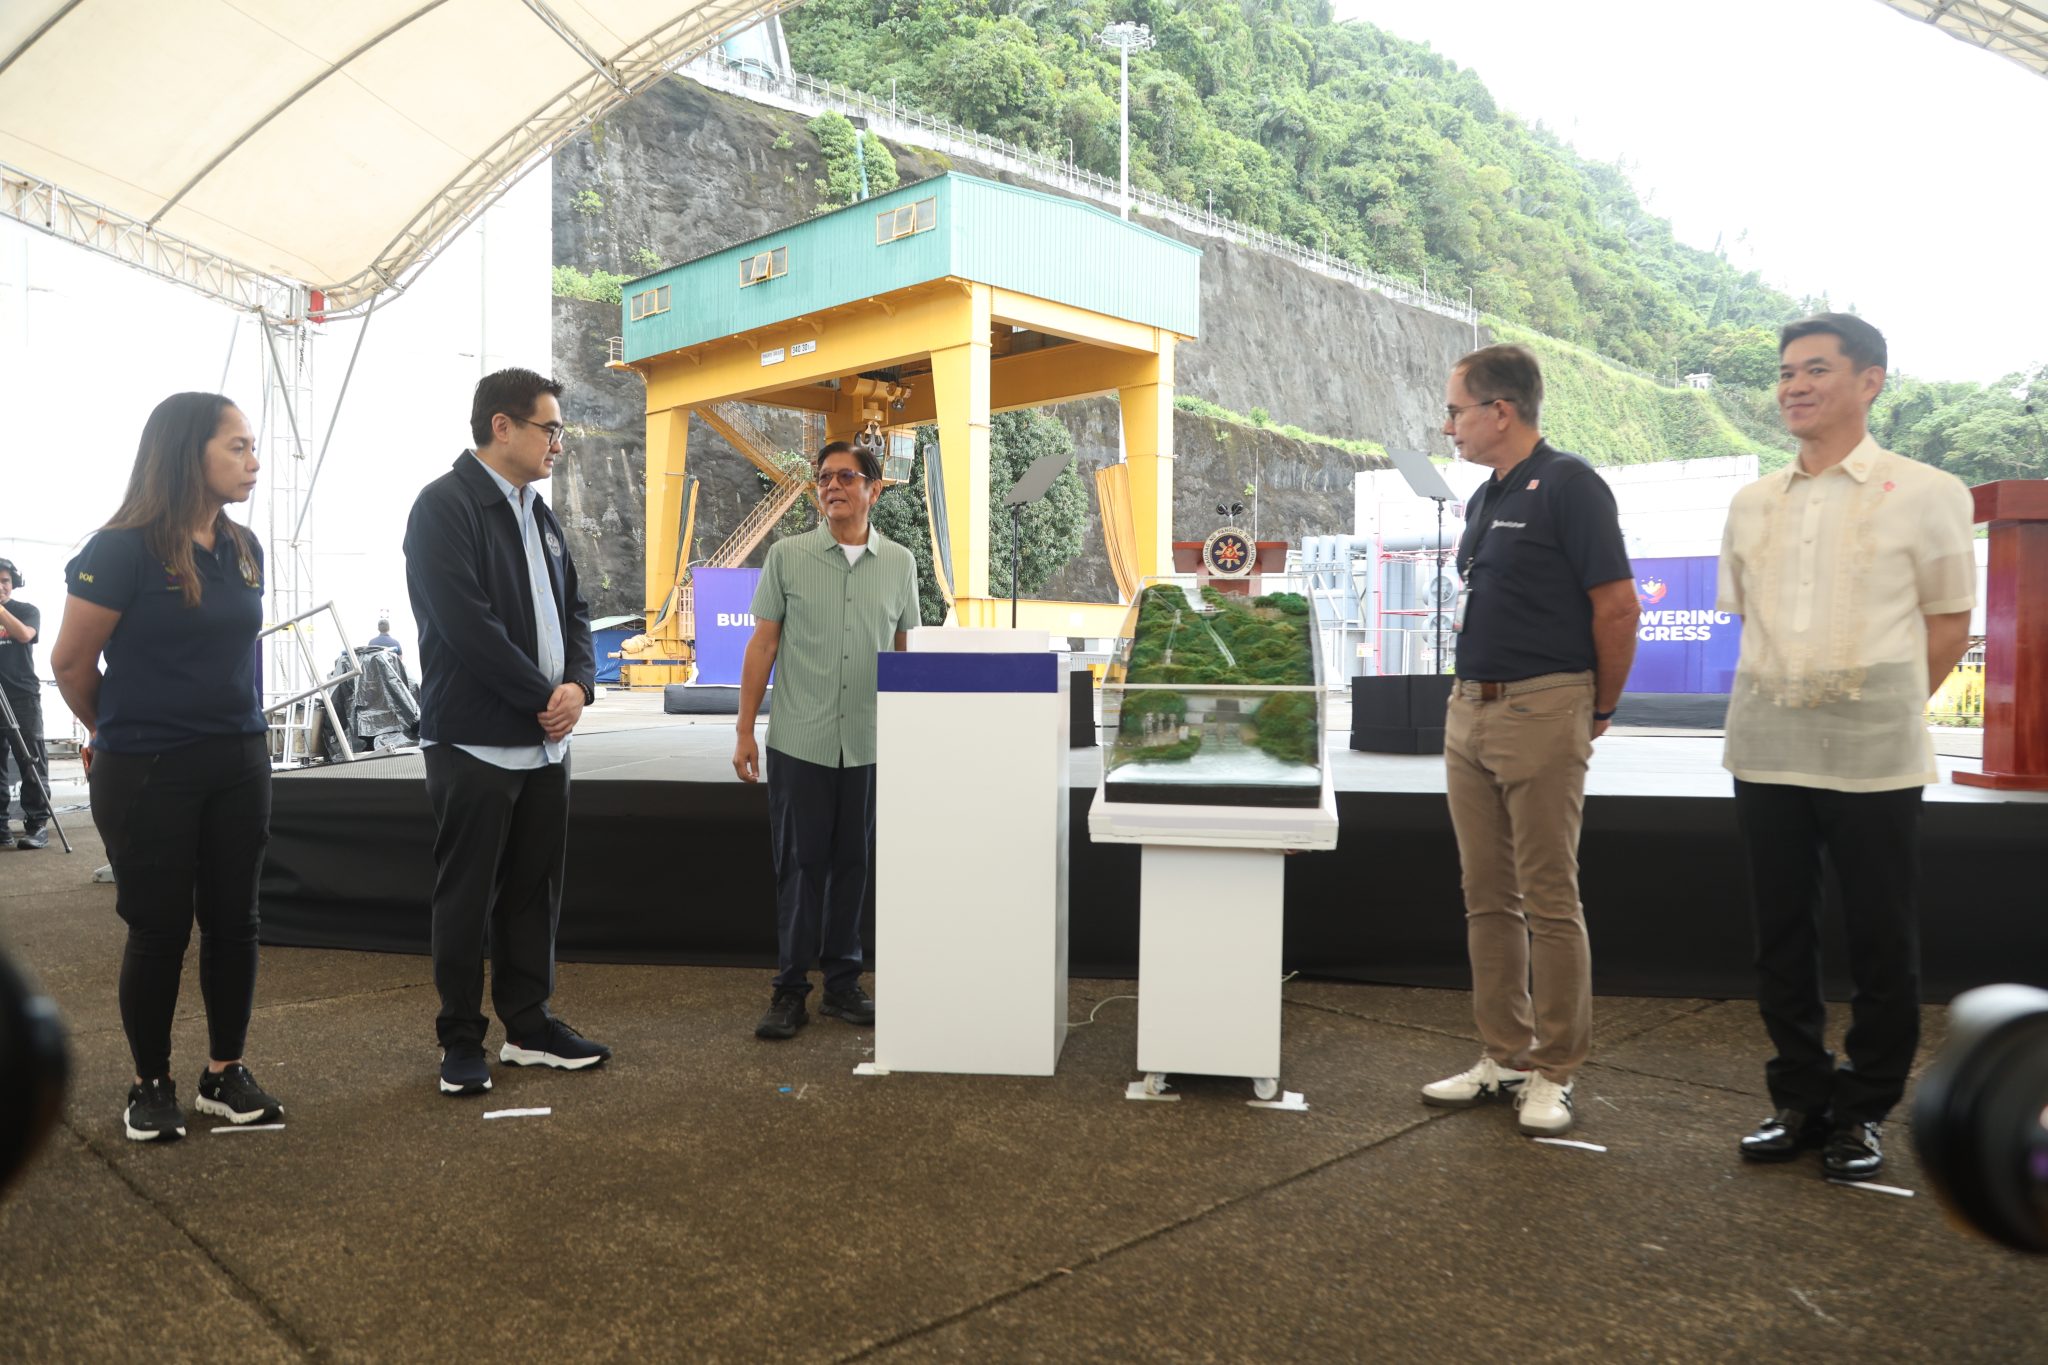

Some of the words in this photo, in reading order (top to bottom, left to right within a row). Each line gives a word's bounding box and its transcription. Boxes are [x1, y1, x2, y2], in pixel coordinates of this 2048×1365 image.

[717, 613, 756, 627] BUIL
[1639, 610, 1731, 625] WERING
[1639, 625, 1712, 641] GRESS
